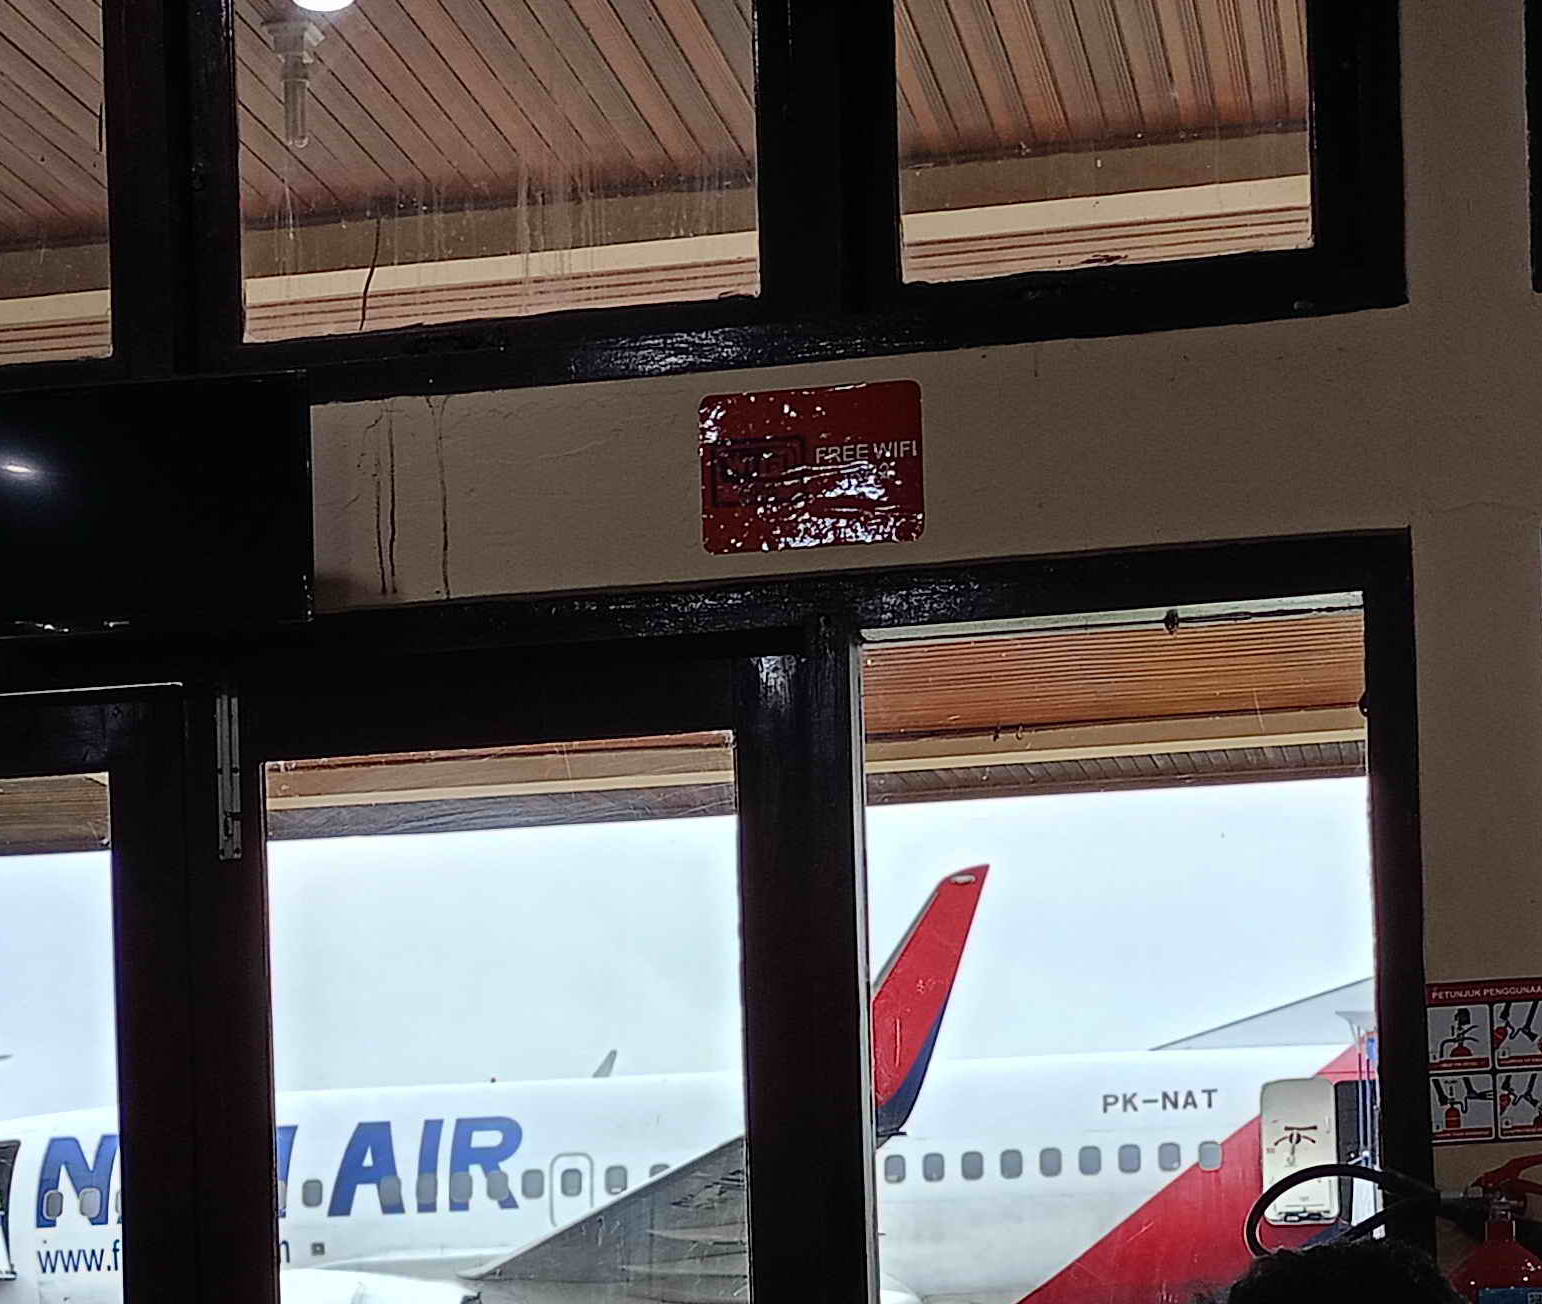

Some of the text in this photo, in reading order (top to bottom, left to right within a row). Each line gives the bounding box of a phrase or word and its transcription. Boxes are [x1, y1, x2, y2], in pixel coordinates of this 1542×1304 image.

[815, 440, 918, 464] FREE WIFI
[1431, 989, 1481, 1000] PETUNJUK
[1102, 1088, 1219, 1114] PK-NAT
[326, 1115, 524, 1218] AIR
